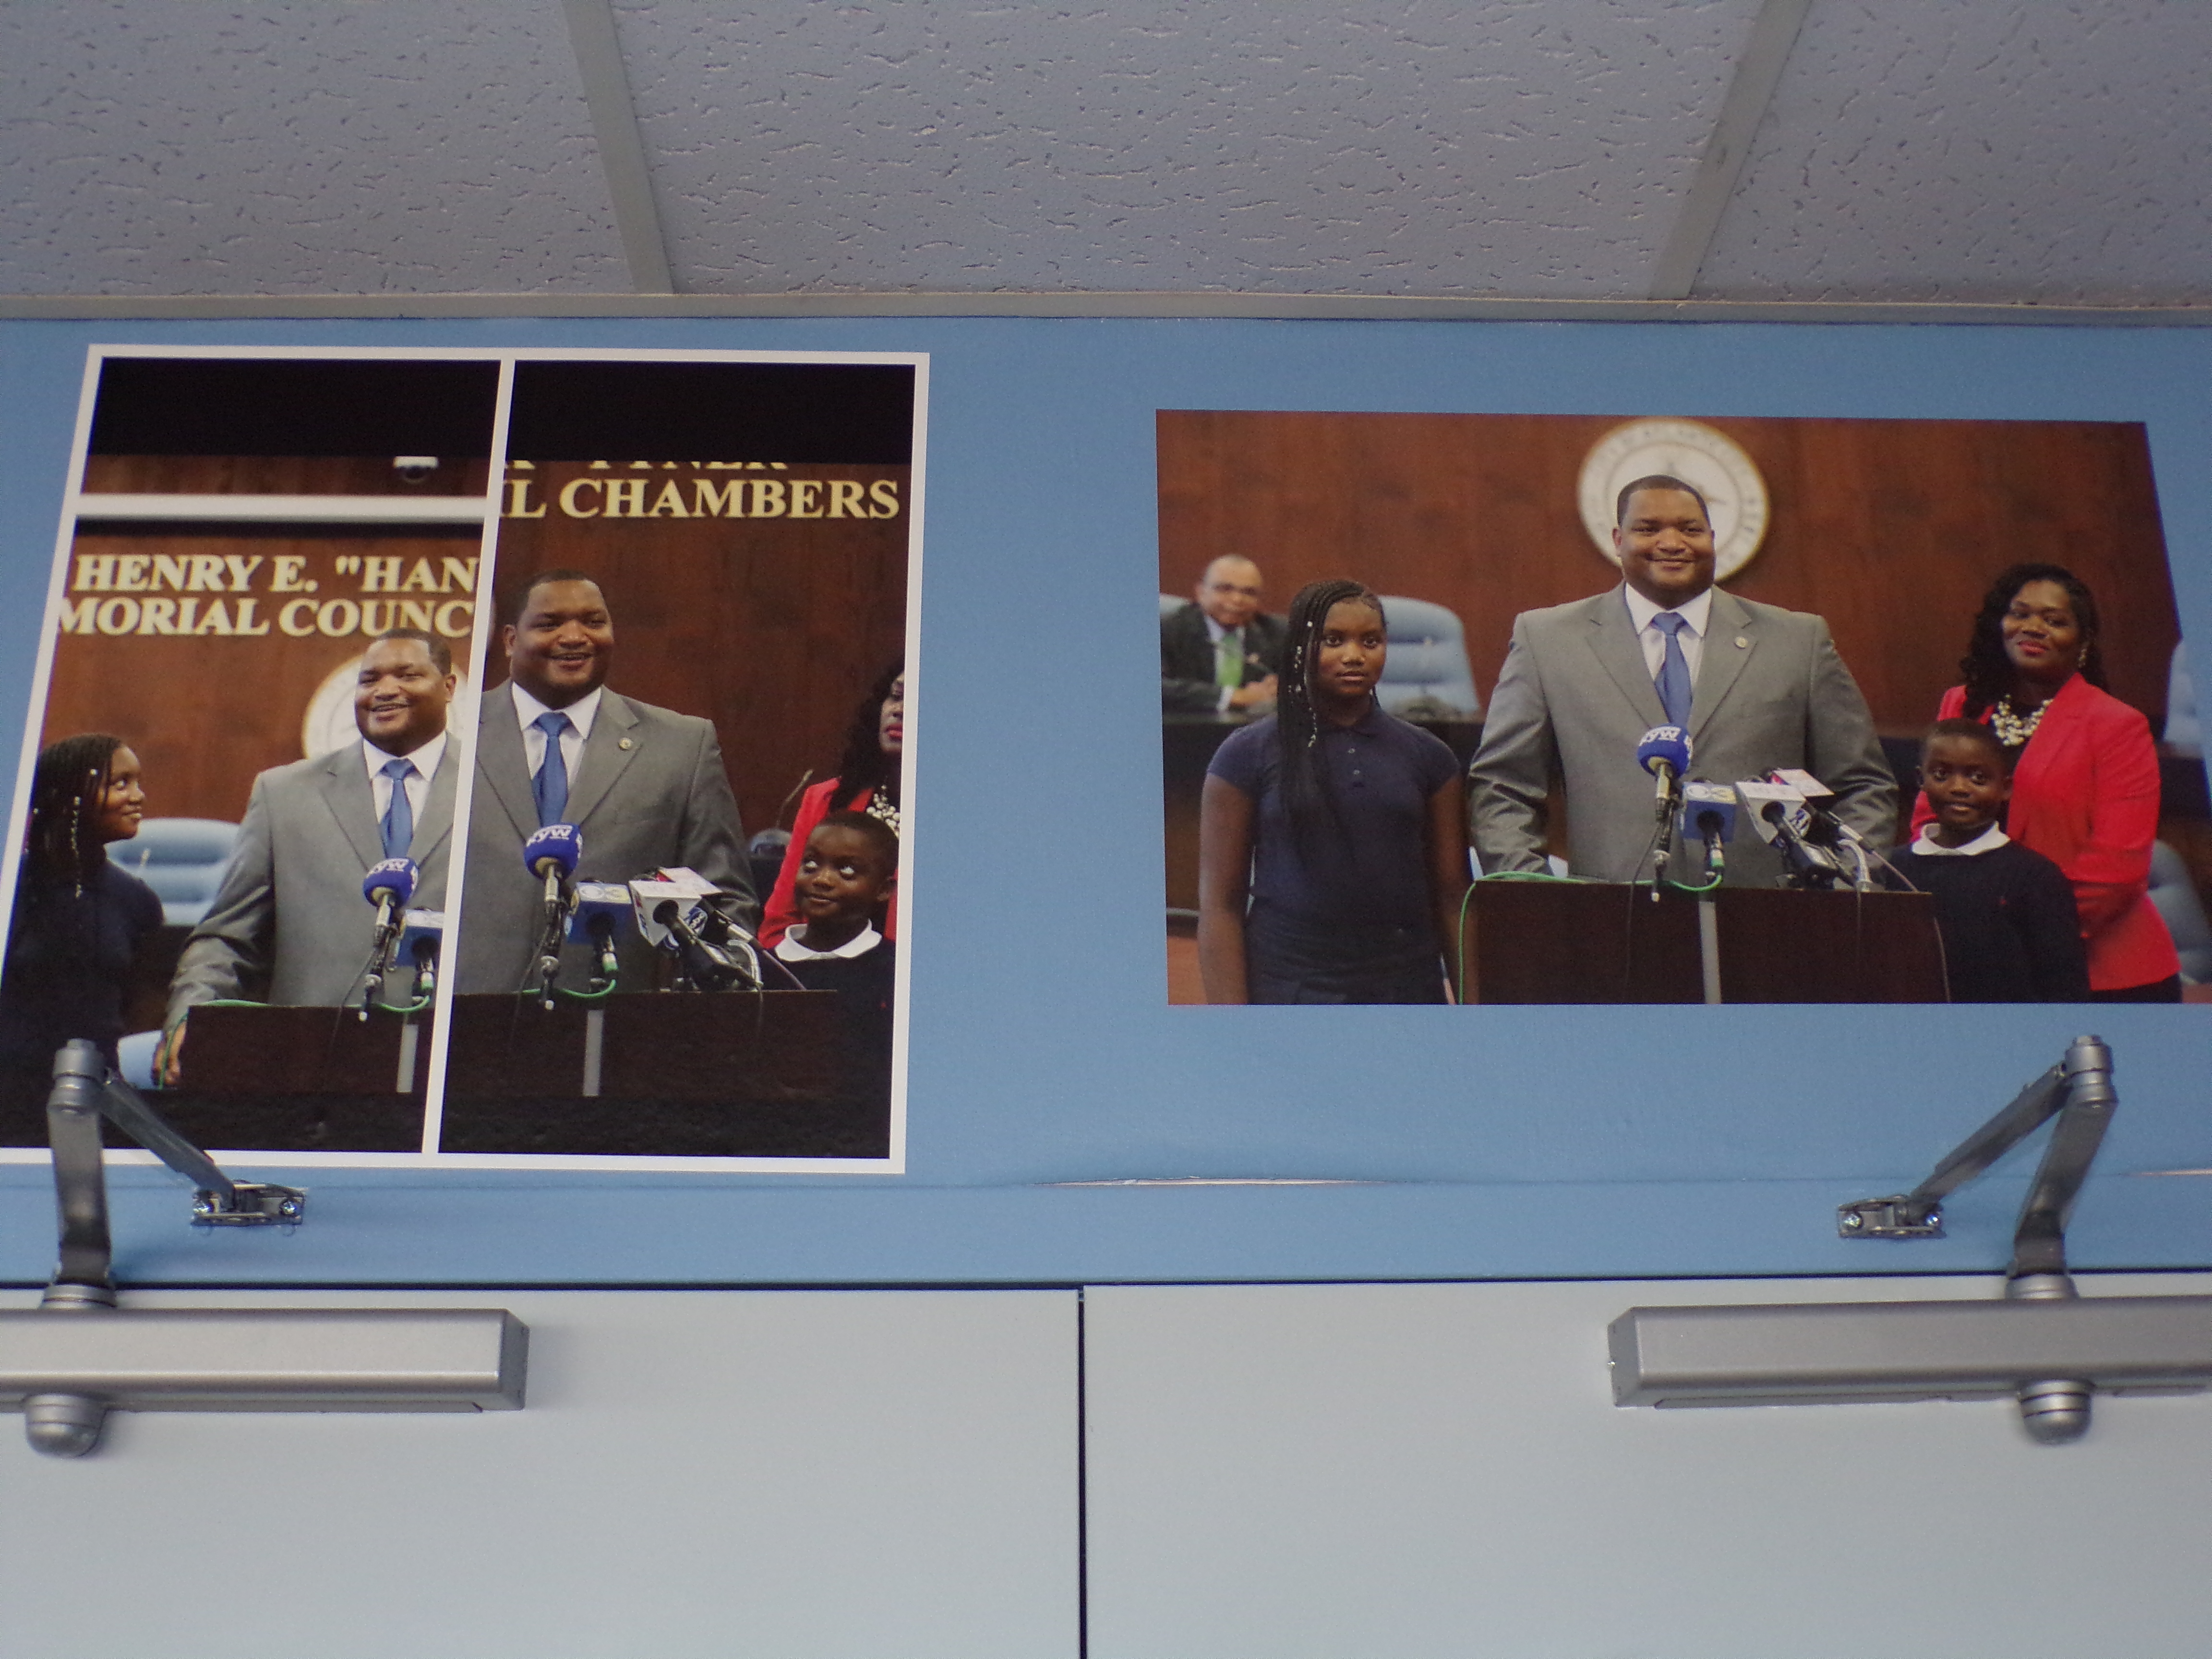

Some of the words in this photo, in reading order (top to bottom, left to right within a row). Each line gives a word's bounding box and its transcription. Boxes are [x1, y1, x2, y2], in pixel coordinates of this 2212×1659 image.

[560, 478, 899, 518] CHAMBERS
[72, 555, 264, 591] HENRY
[269, 555, 318, 592] E.
[336, 556, 480, 593] "HAN
[279, 598, 476, 637] COUNC
